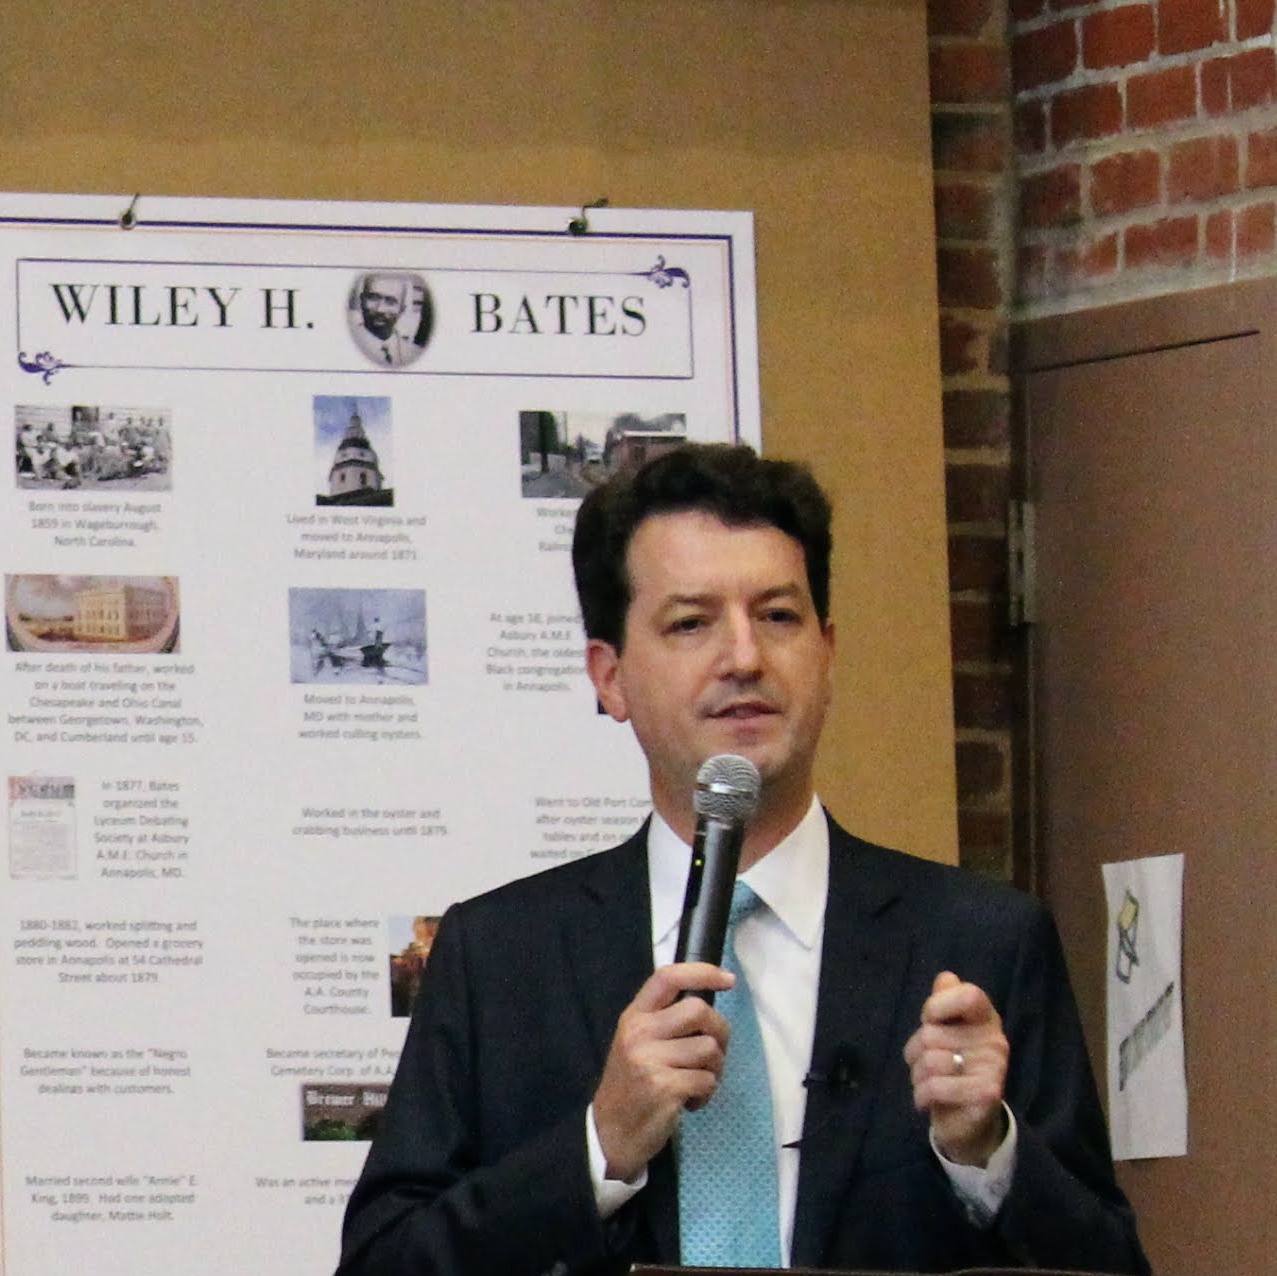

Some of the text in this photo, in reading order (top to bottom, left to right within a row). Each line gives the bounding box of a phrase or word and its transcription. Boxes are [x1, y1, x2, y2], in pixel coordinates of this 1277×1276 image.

[50, 283, 647, 337] WILEY H. BATES
